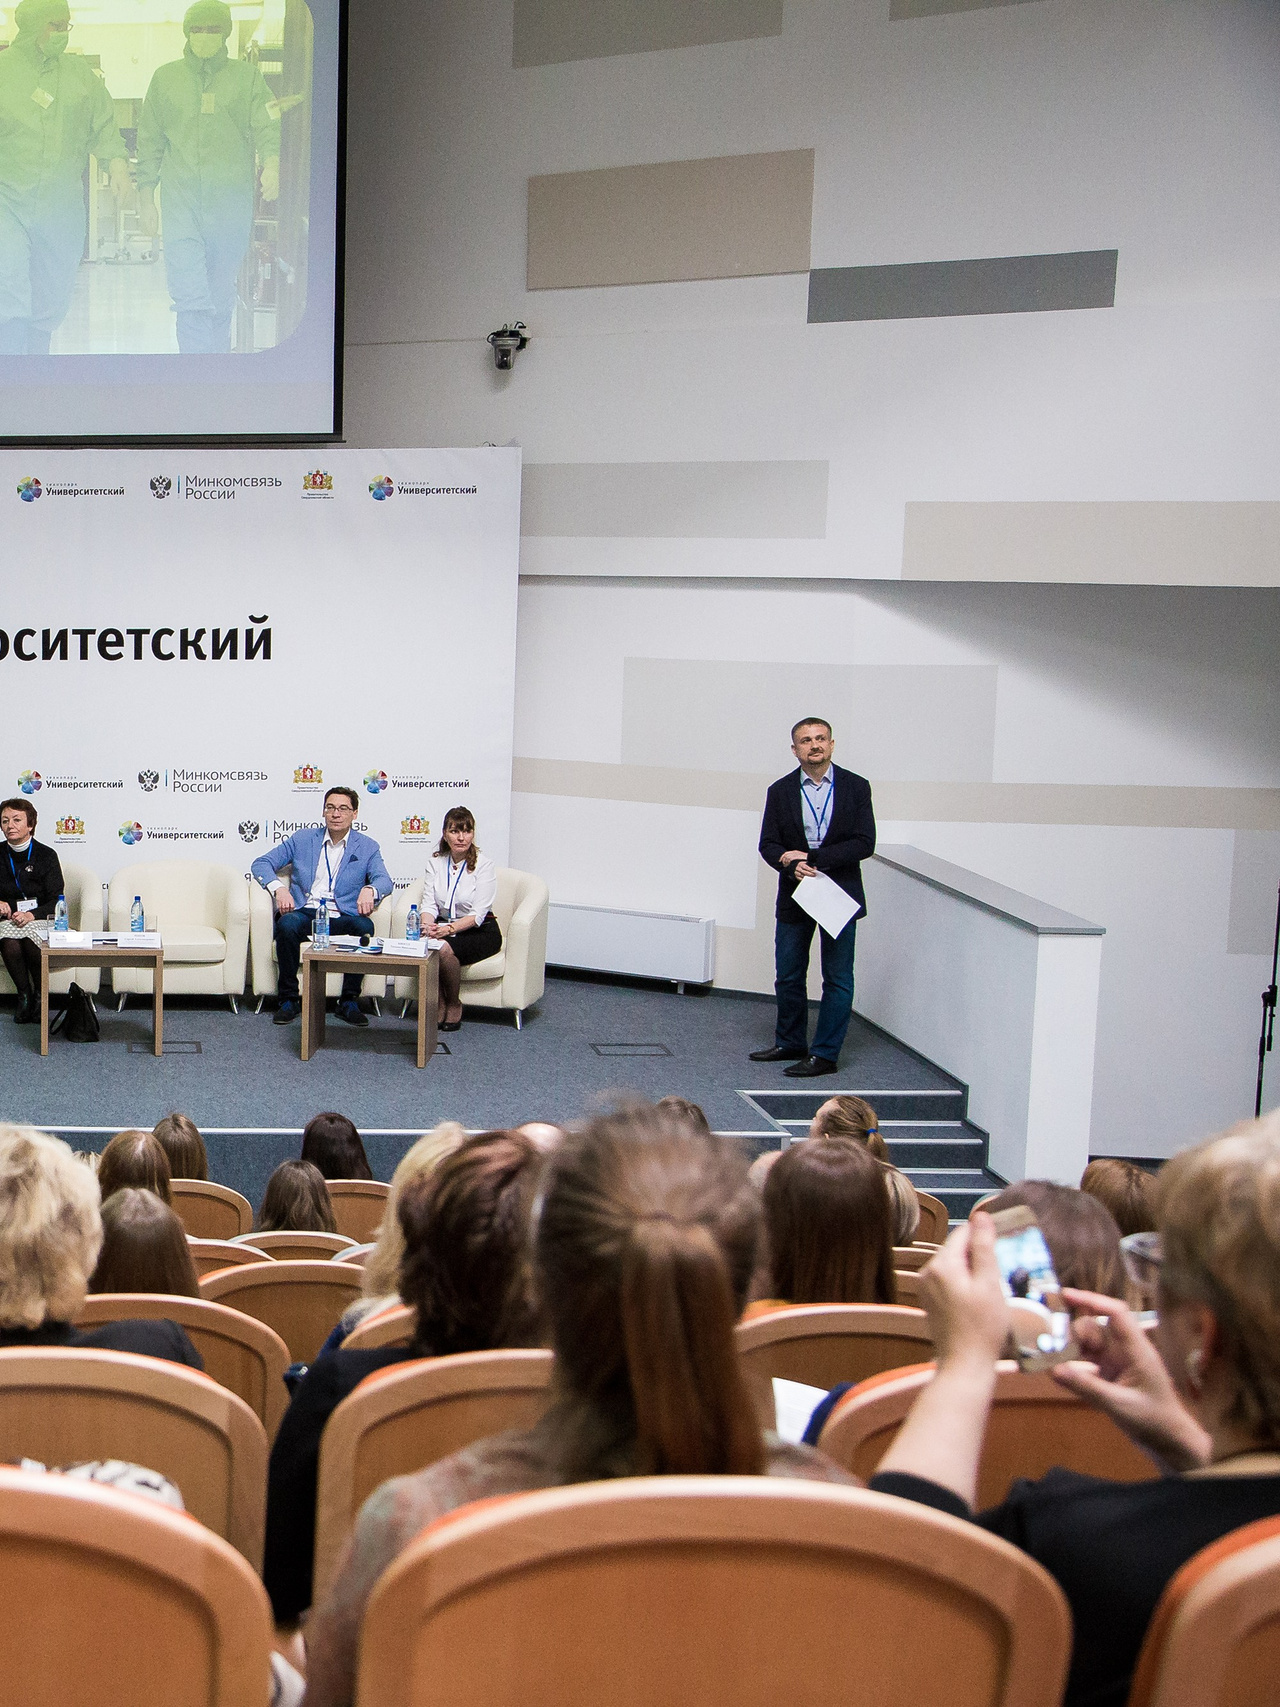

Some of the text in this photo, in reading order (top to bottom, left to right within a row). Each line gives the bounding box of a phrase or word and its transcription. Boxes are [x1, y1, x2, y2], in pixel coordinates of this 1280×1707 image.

[45, 486, 125, 498] Университетский
[185, 487, 236, 500] России
[397, 486, 477, 497] Университетский
[45, 780, 124, 791] Университетский
[173, 781, 222, 793] России
[391, 780, 470, 790] Университетский
[146, 830, 224, 841] Университетский
